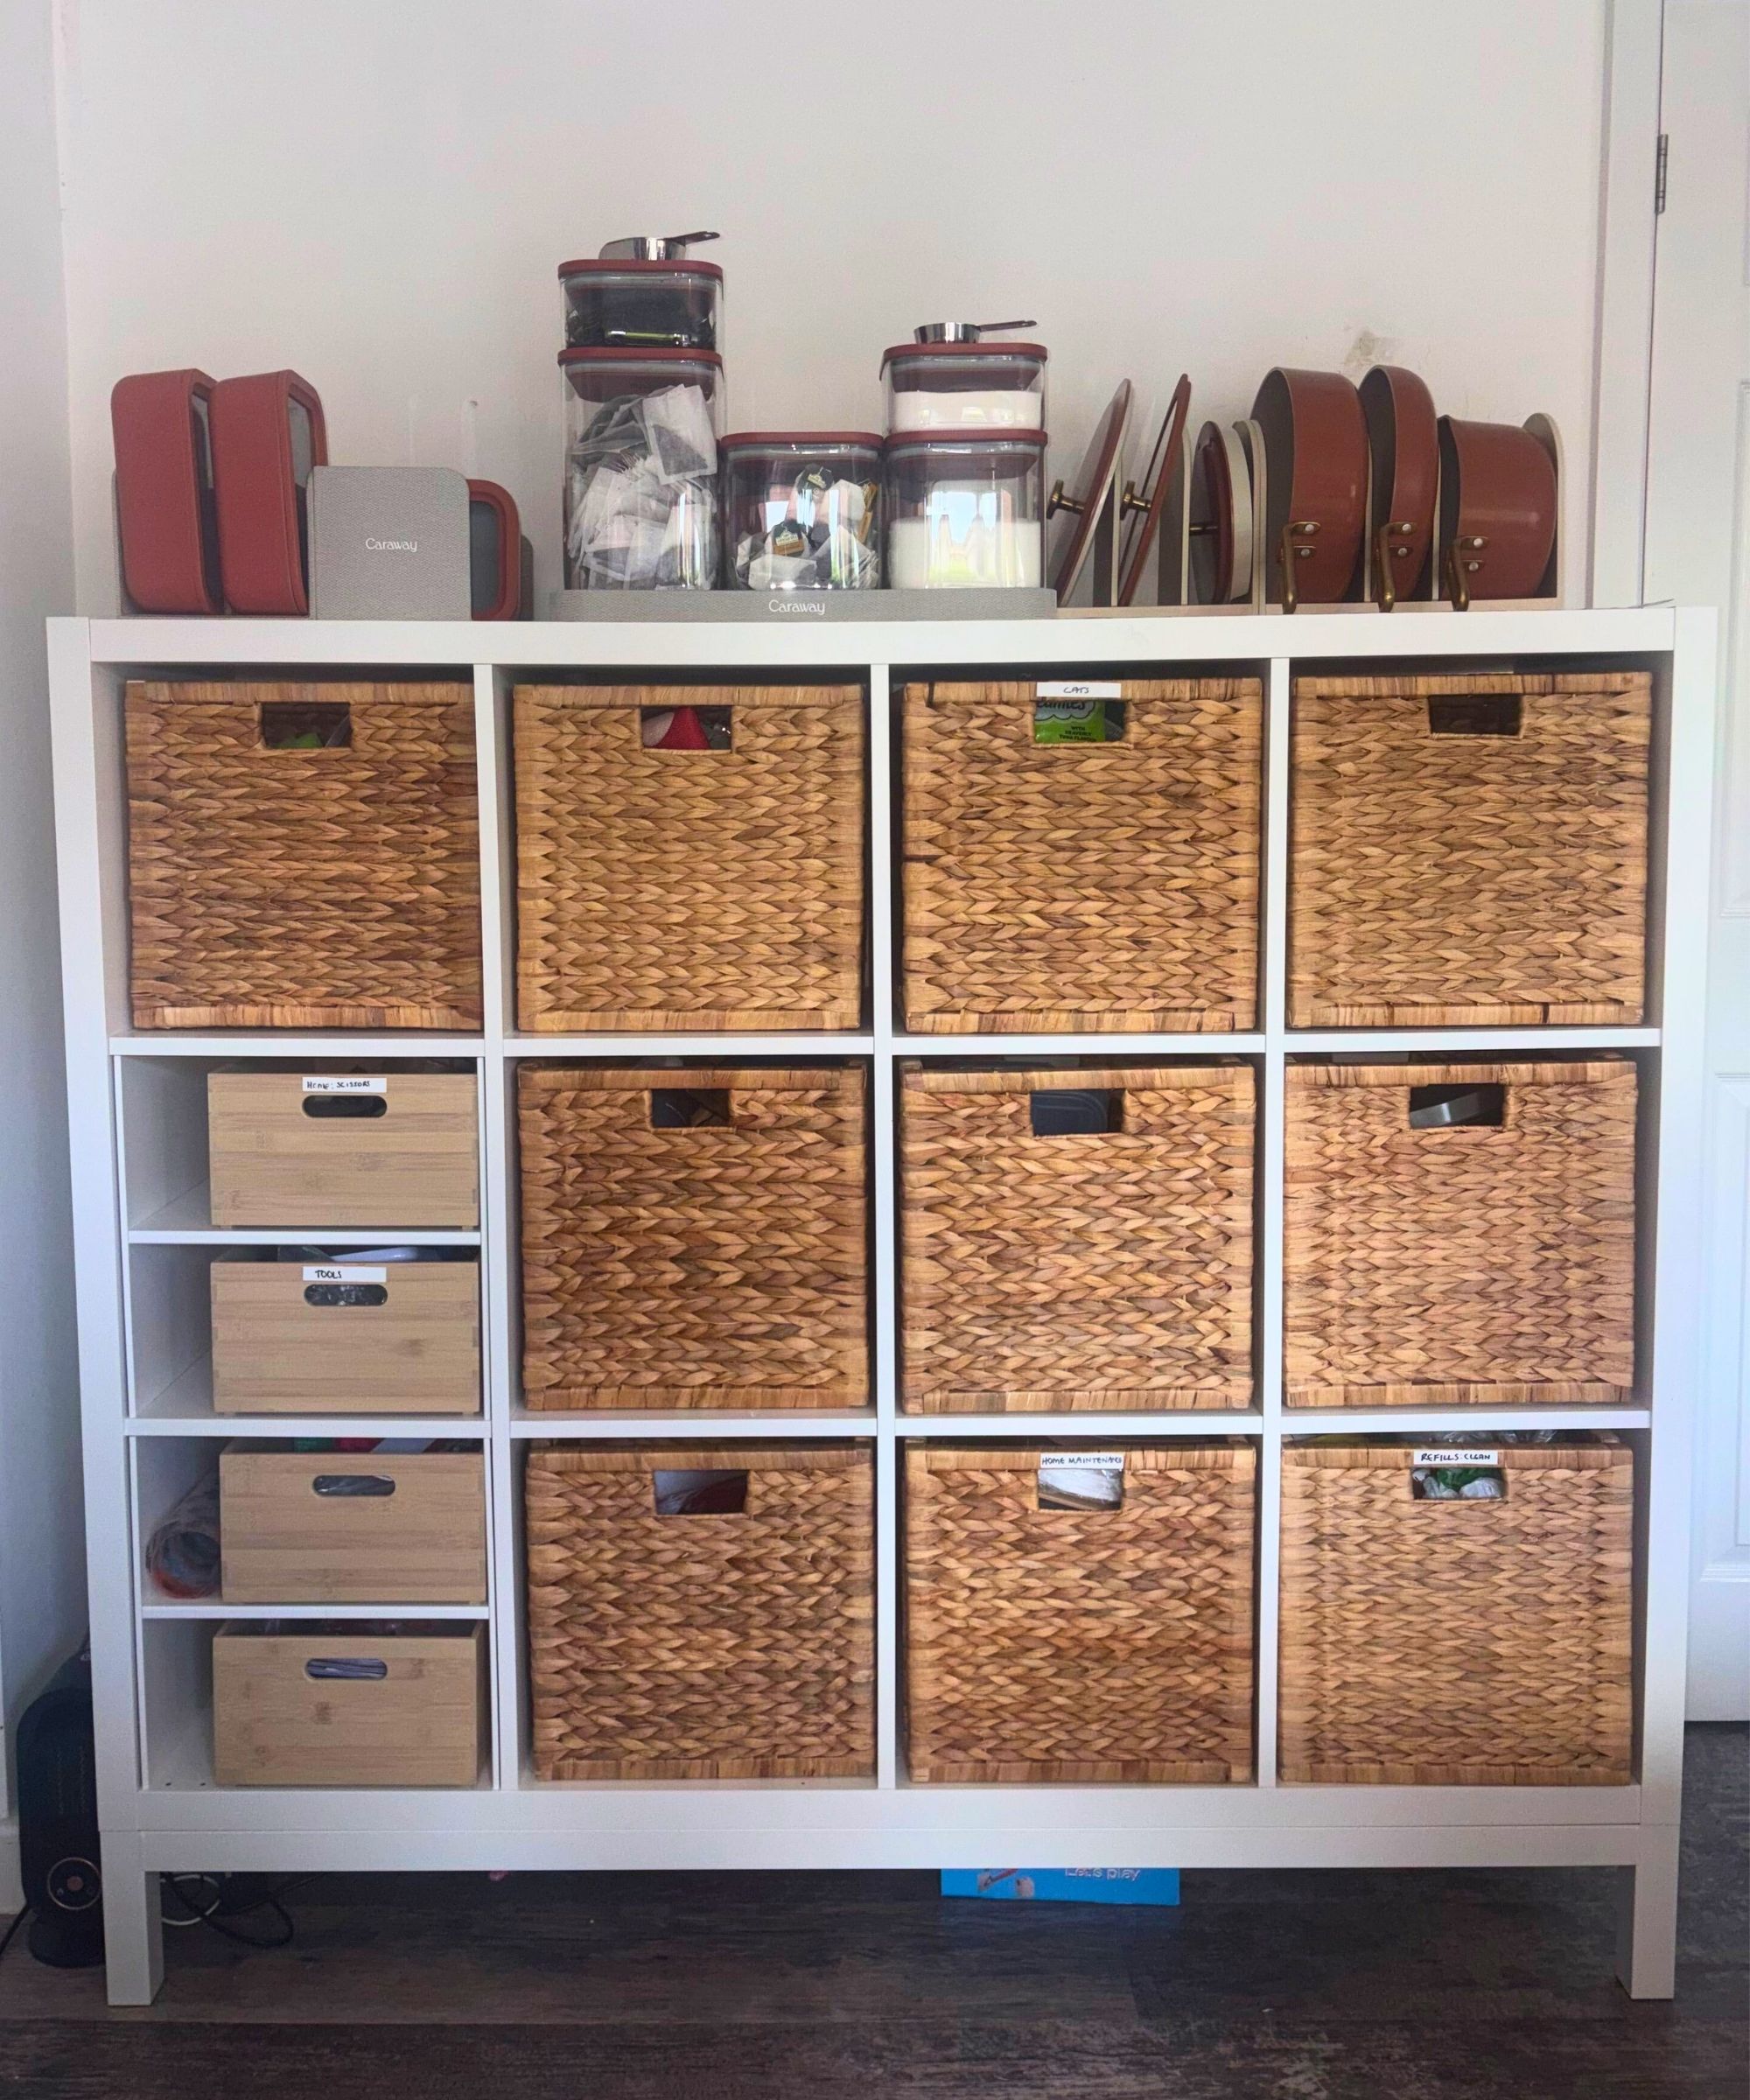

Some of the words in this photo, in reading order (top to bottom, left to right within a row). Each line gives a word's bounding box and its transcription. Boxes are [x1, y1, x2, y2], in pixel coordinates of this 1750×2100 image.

[365, 537, 417, 553] Caraway
[768, 599, 825, 616] Caraway
[315, 1270, 342, 1279] TOOLS
[1041, 1456, 1065, 1465] HOME
[1106, 1868, 1141, 1881] play
